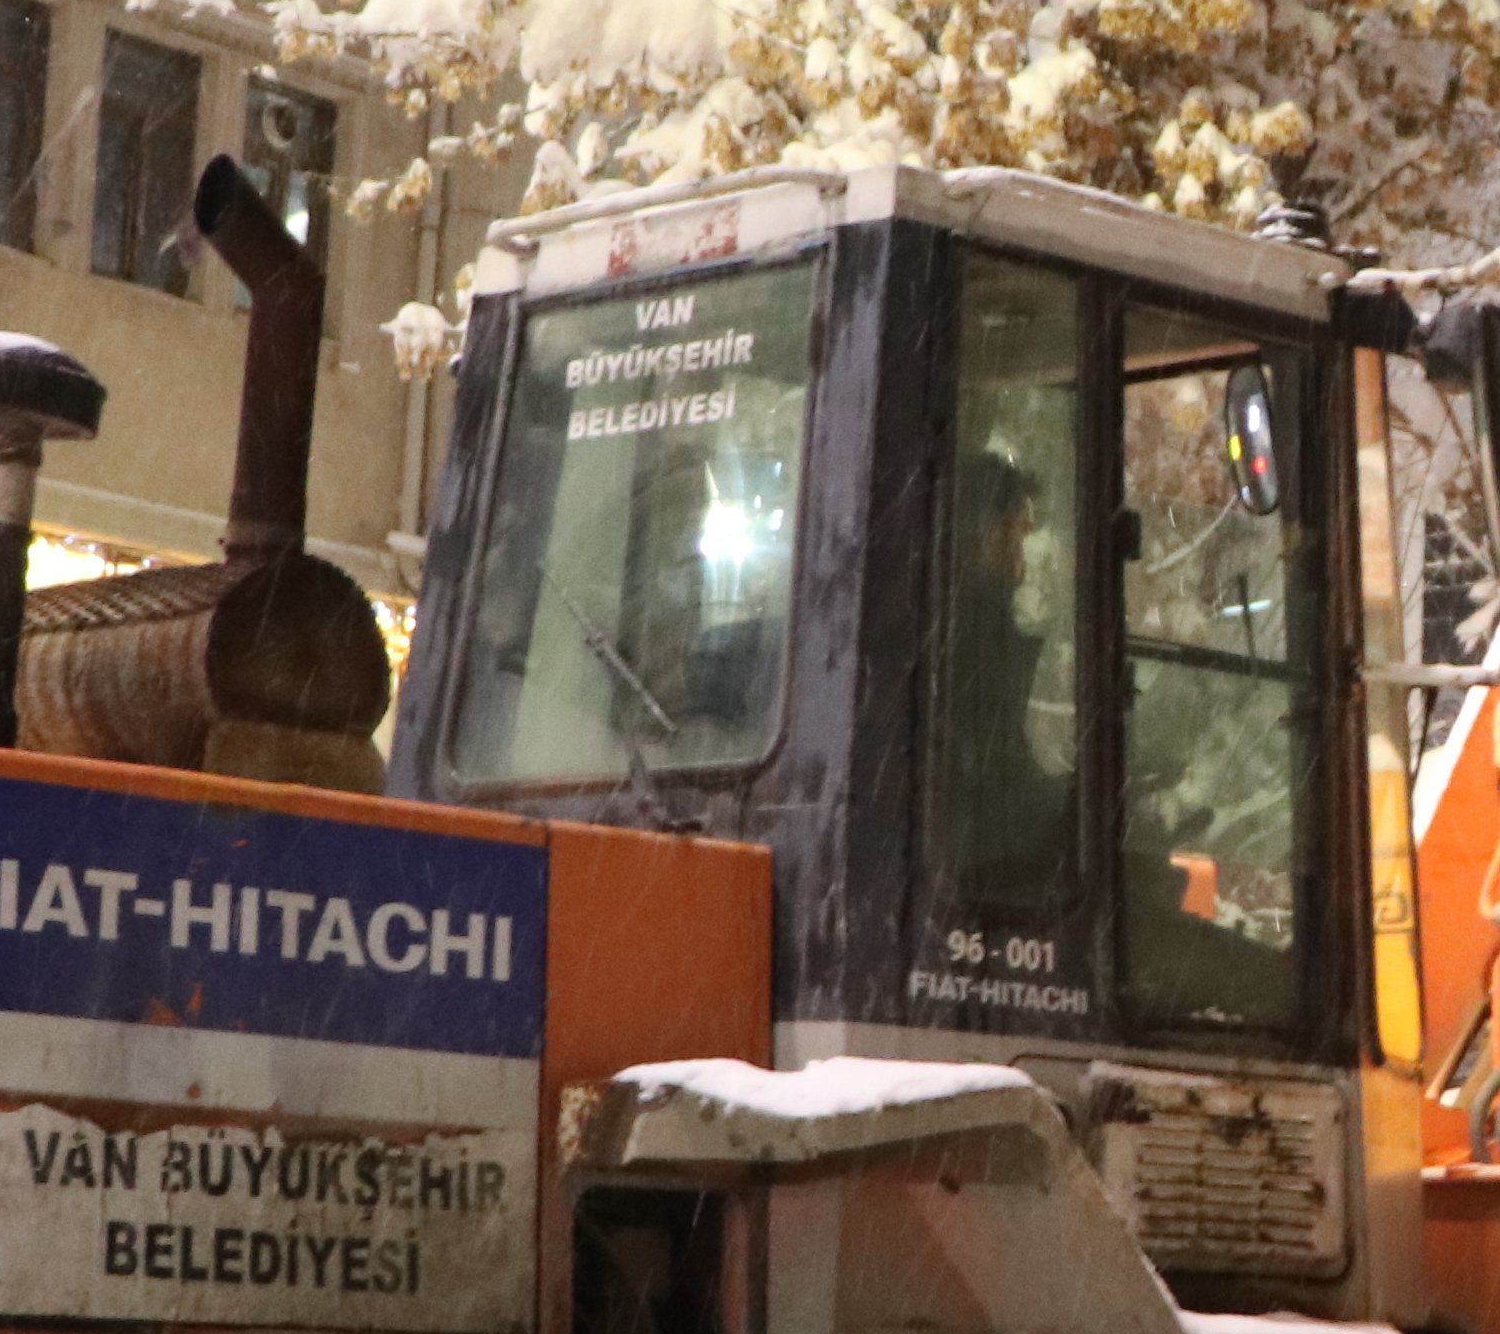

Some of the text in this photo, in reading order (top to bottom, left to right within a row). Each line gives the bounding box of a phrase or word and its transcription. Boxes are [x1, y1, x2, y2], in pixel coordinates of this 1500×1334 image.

[636, 294, 695, 330] VAN
[565, 327, 754, 389] BÜYÜKŞEHİR
[567, 385, 738, 441] BELEDİYESİ
[947, 928, 987, 964] 96
[1006, 935, 1056, 973] 001
[908, 971, 1089, 1016] FIAT-HITACHI
[23, 1126, 140, 1192] VAN
[104, 1217, 421, 1296] BELEDİYESİ
